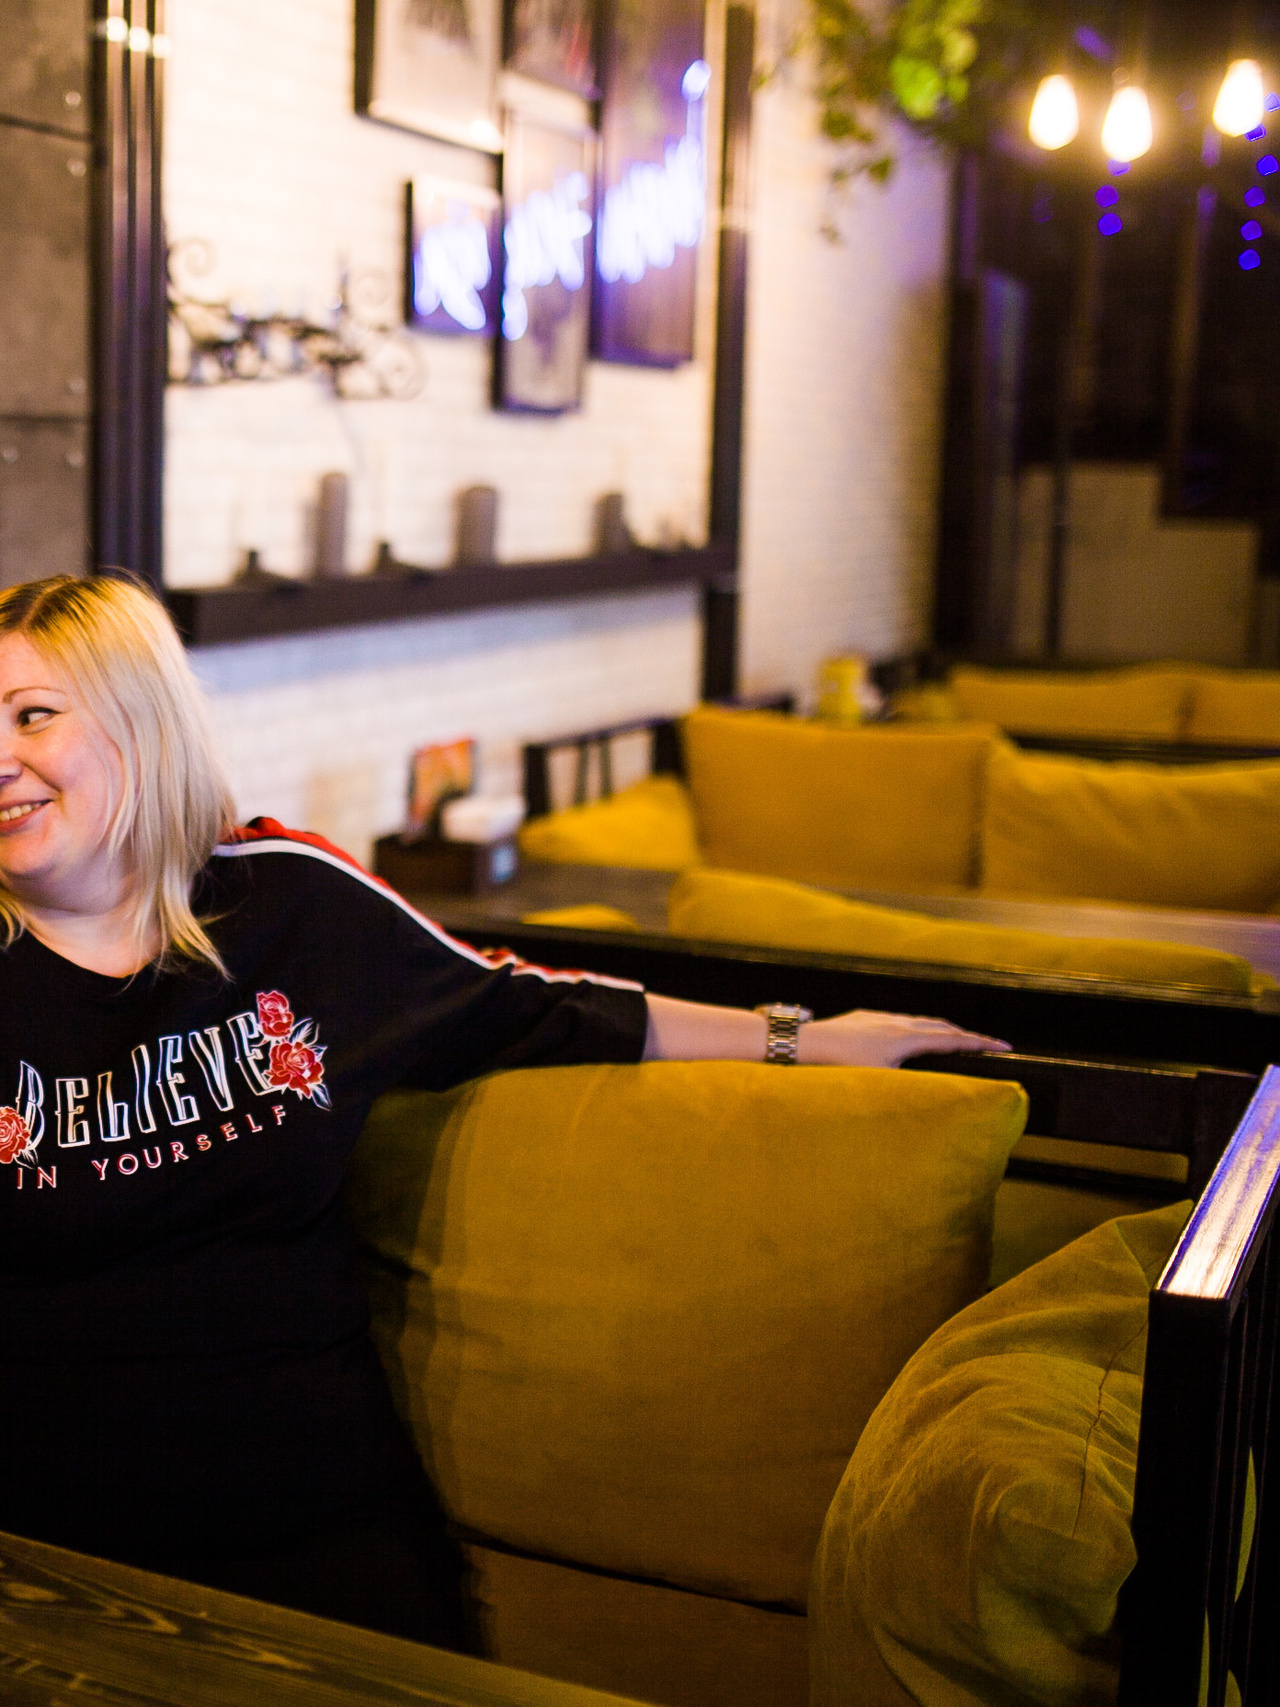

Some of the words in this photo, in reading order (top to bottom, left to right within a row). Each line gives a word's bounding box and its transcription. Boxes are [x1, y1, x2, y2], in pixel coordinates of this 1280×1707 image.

[16, 1012, 278, 1147] BELIEVE
[17, 1166, 57, 1189] IN
[91, 1105, 286, 1180] YOURSELF
